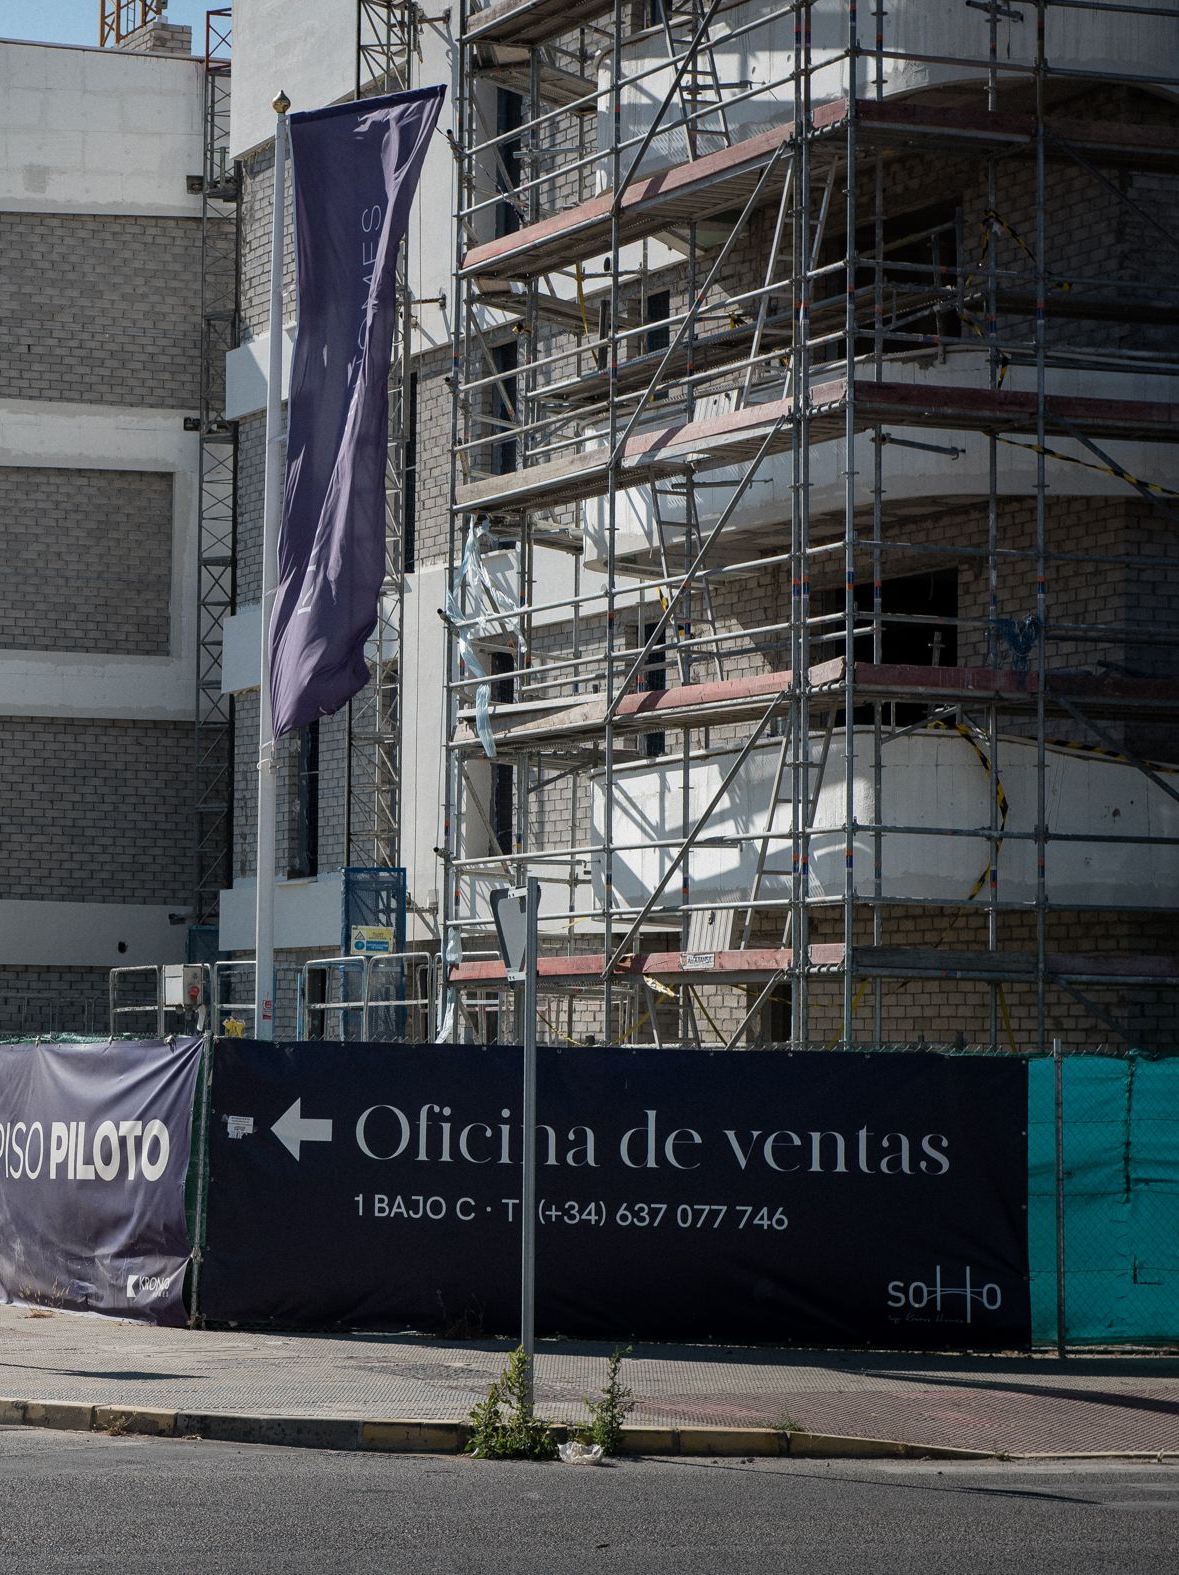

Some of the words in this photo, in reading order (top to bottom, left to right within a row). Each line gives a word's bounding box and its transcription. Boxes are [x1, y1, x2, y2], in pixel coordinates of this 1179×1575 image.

[49, 1119, 170, 1181] PILOTO
[355, 1103, 600, 1168] Oficina
[619, 1109, 703, 1170] de
[722, 1124, 951, 1175] ventas
[354, 1194, 364, 1216] 1
[374, 1194, 447, 1219] BAJO
[456, 1197, 476, 1221] C
[538, 1199, 606, 1225] (+34)
[615, 1202, 667, 1226] 637
[676, 1203, 728, 1228] 077
[736, 1206, 789, 1230] 746
[887, 1264, 1002, 1324] SOHO
